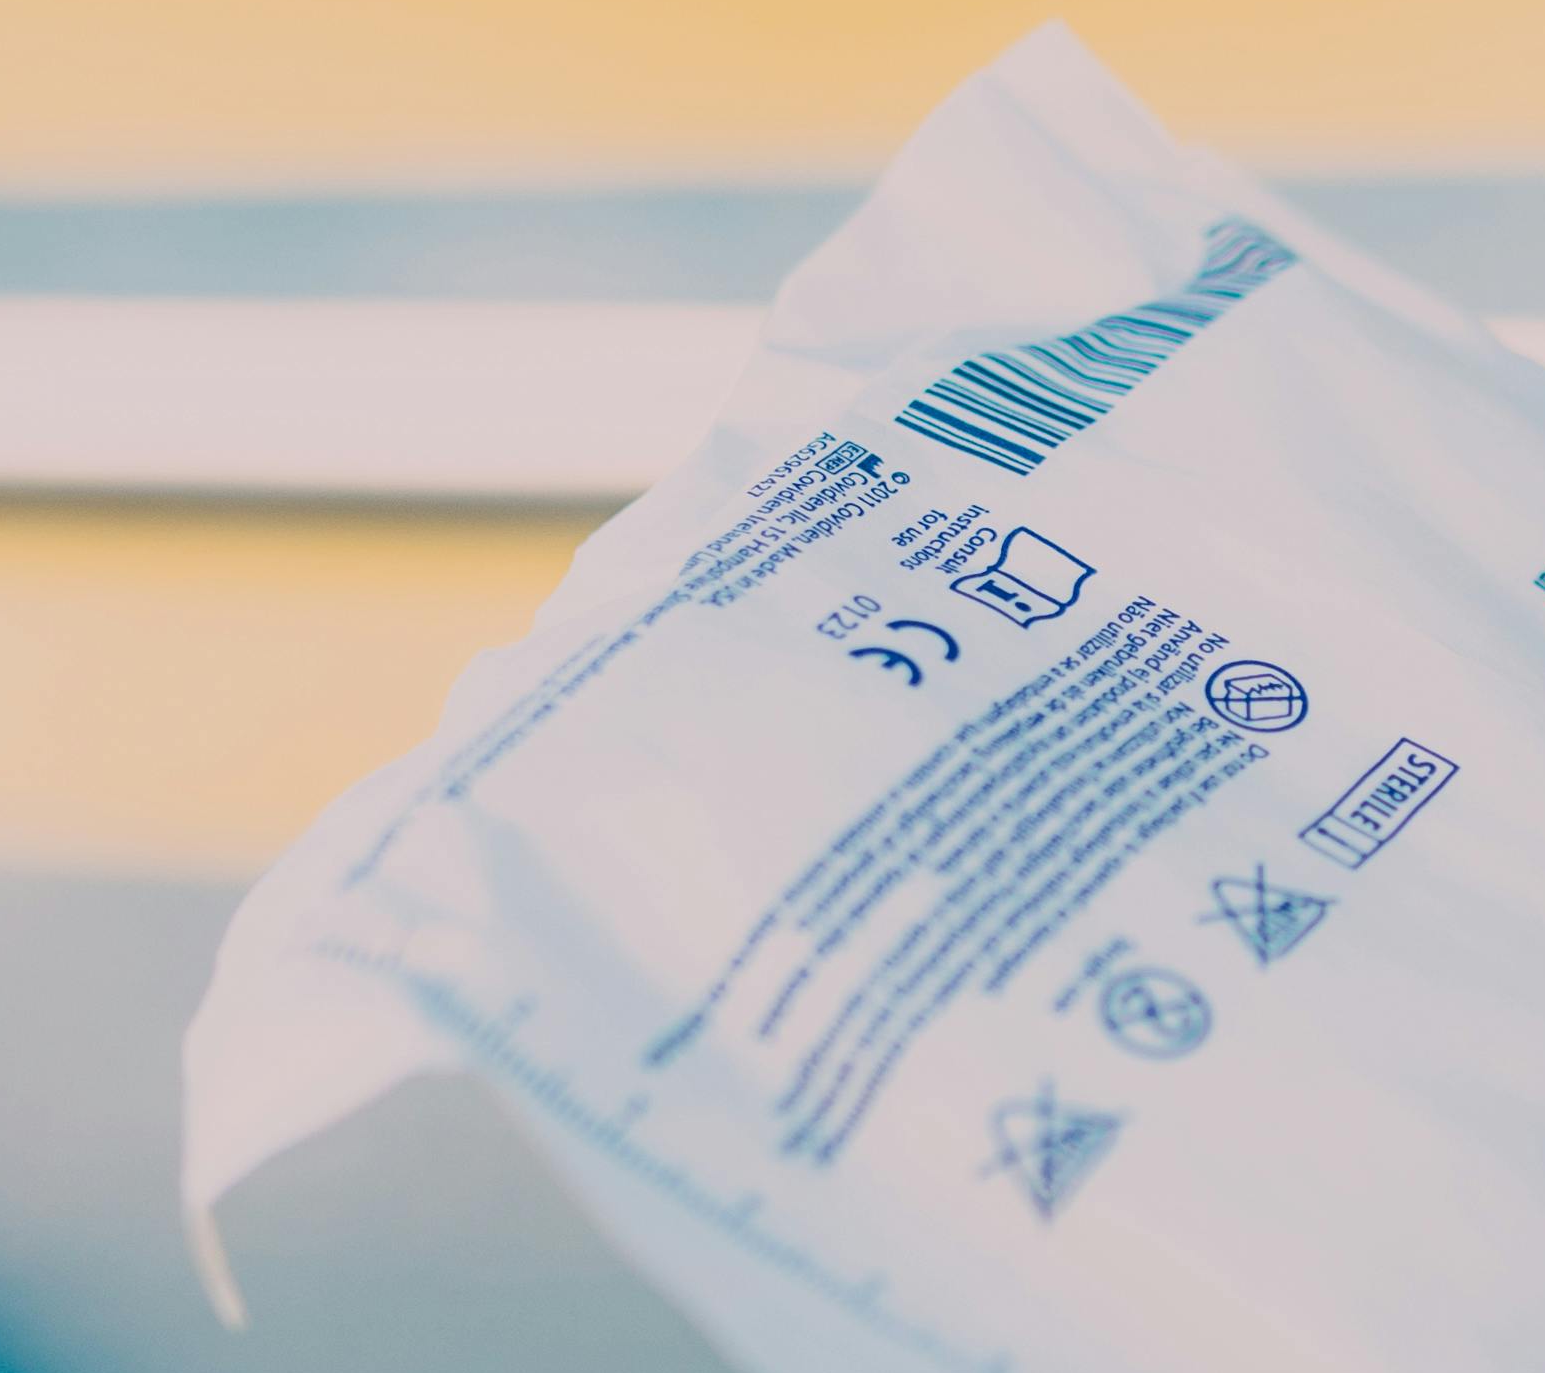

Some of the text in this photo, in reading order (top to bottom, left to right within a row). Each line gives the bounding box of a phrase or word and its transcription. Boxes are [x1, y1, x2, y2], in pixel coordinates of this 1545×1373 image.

[758, 470, 827, 513] Covidien
[800, 472, 868, 511] Covidien
[858, 481, 898, 507] 2011
[761, 527, 783, 540] 15
[892, 510, 948, 546] for use
[900, 505, 989, 569] instructions
[751, 543, 801, 577] Made
[936, 528, 997, 573] Consult
[817, 595, 881, 639] 0123
[1118, 596, 1156, 623] Não
[1140, 609, 1180, 637] Niet
[1077, 622, 1121, 659] utilizar
[1145, 620, 1202, 671] Använd
[1199, 634, 1229, 654] No
[1081, 635, 1144, 686] gebruiken
[1127, 669, 1149, 680] ej
[1156, 653, 1203, 695] utilizar
[1351, 754, 1436, 831] STERILE
